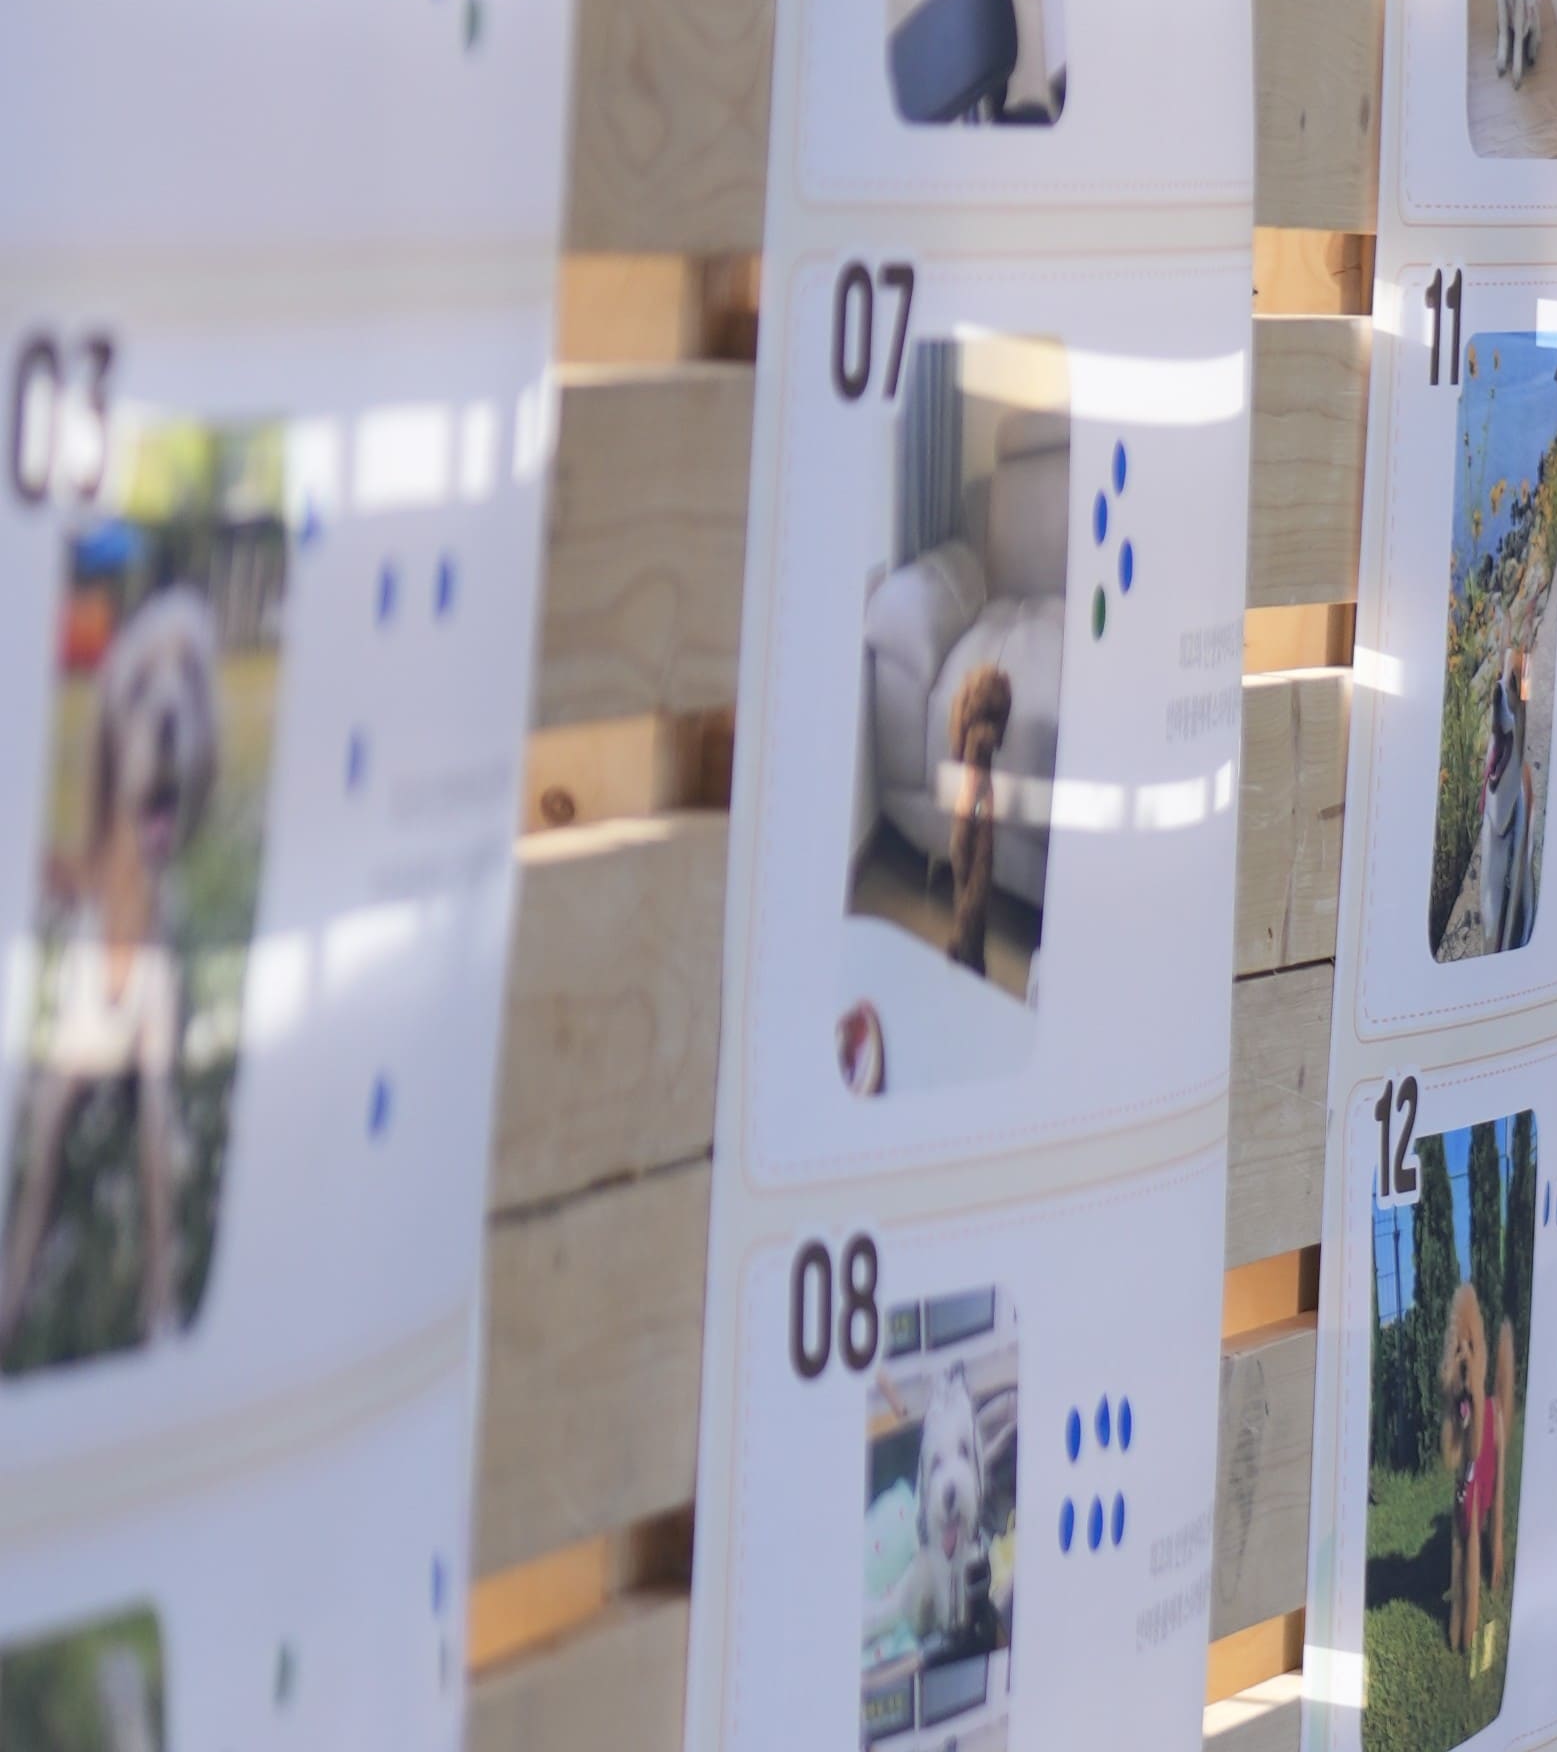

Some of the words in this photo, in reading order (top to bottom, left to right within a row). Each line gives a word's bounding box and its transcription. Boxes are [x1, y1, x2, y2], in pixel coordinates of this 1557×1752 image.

[831, 260, 914, 401] 07
[1425, 268, 1462, 386] 11
[10, 331, 114, 504] 03
[1375, 1076, 1418, 1197] 12
[789, 1238, 879, 1381] 08
